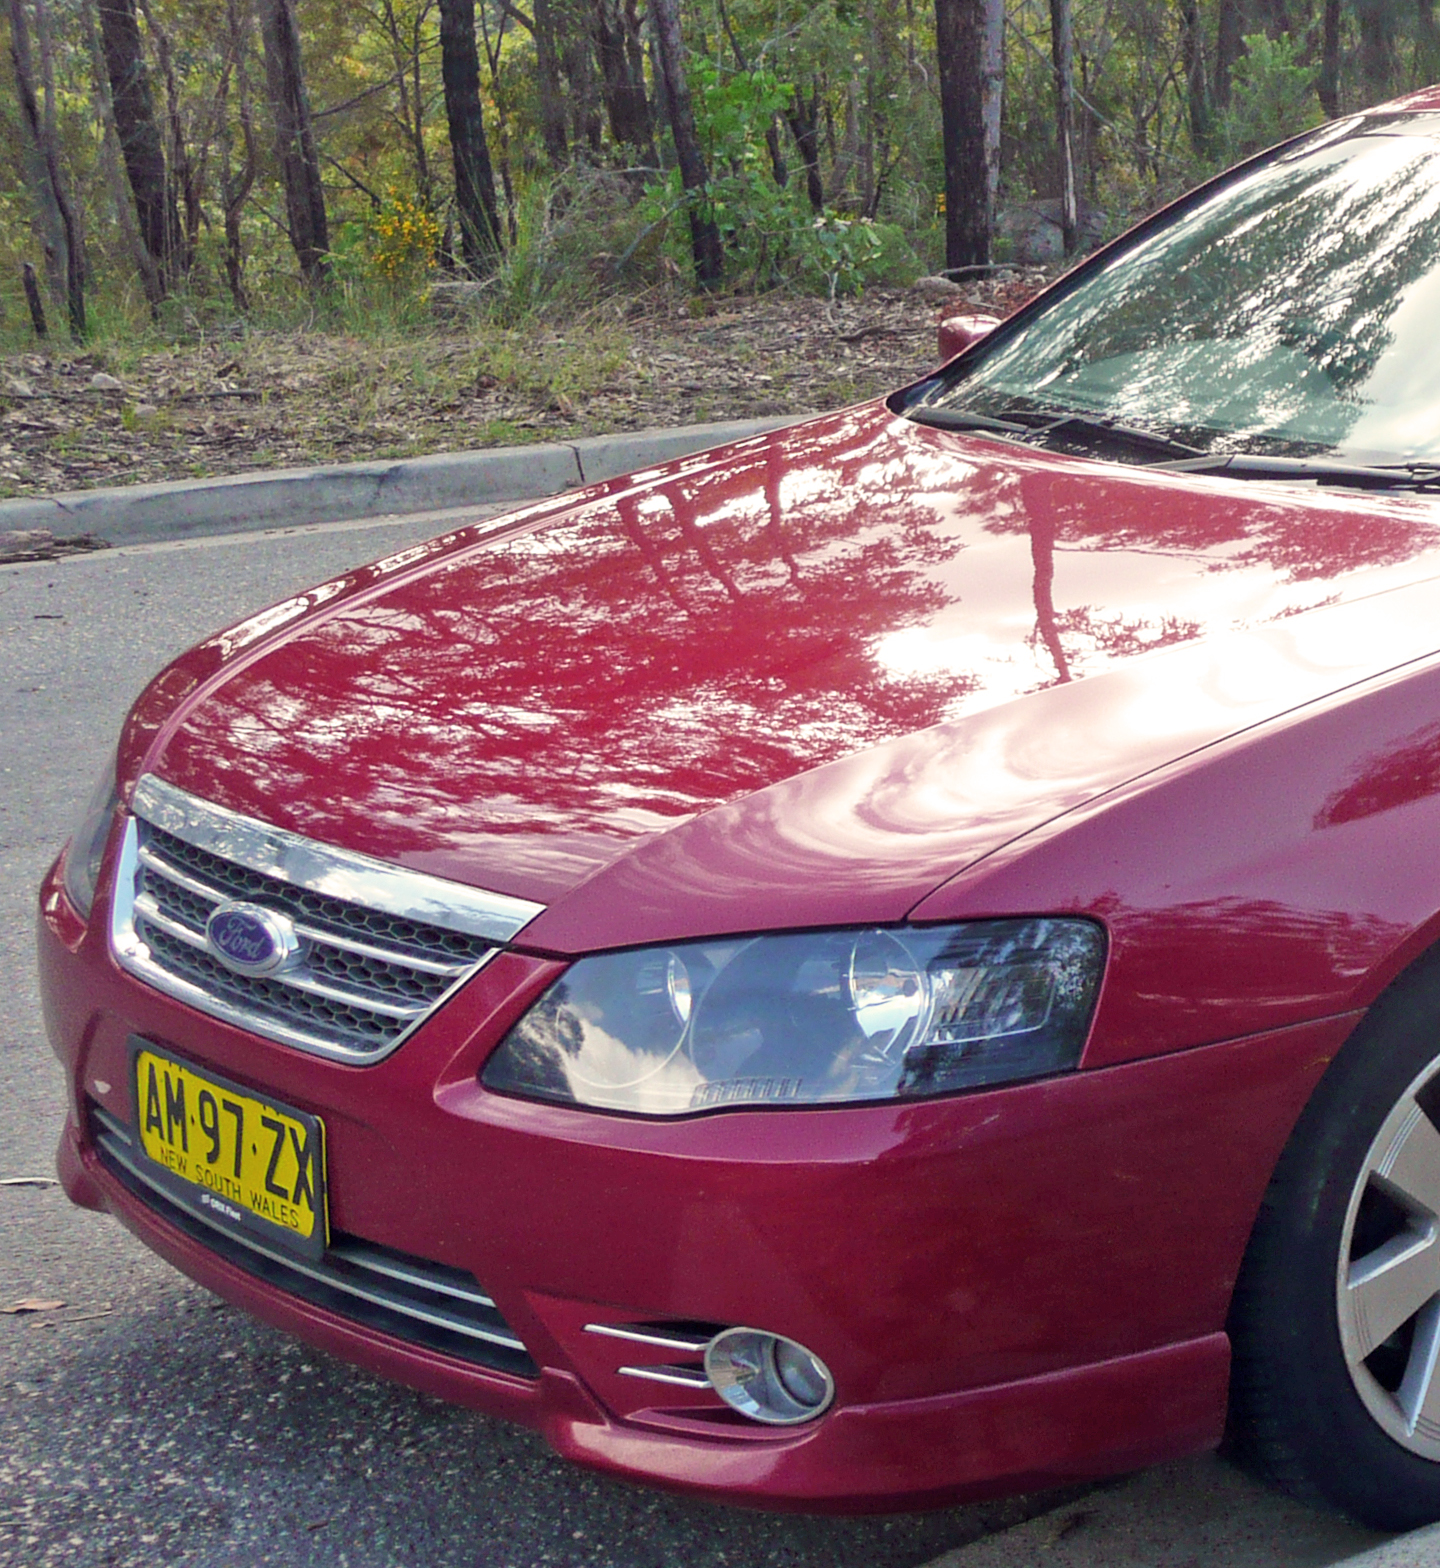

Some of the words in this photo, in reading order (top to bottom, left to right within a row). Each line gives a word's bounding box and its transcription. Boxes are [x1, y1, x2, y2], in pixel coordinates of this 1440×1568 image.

[220, 916, 266, 958] Ford
[160, 1147, 187, 1174] NEW
[195, 1164, 242, 1202] SOUTH
[250, 1190, 299, 1229] WALES
